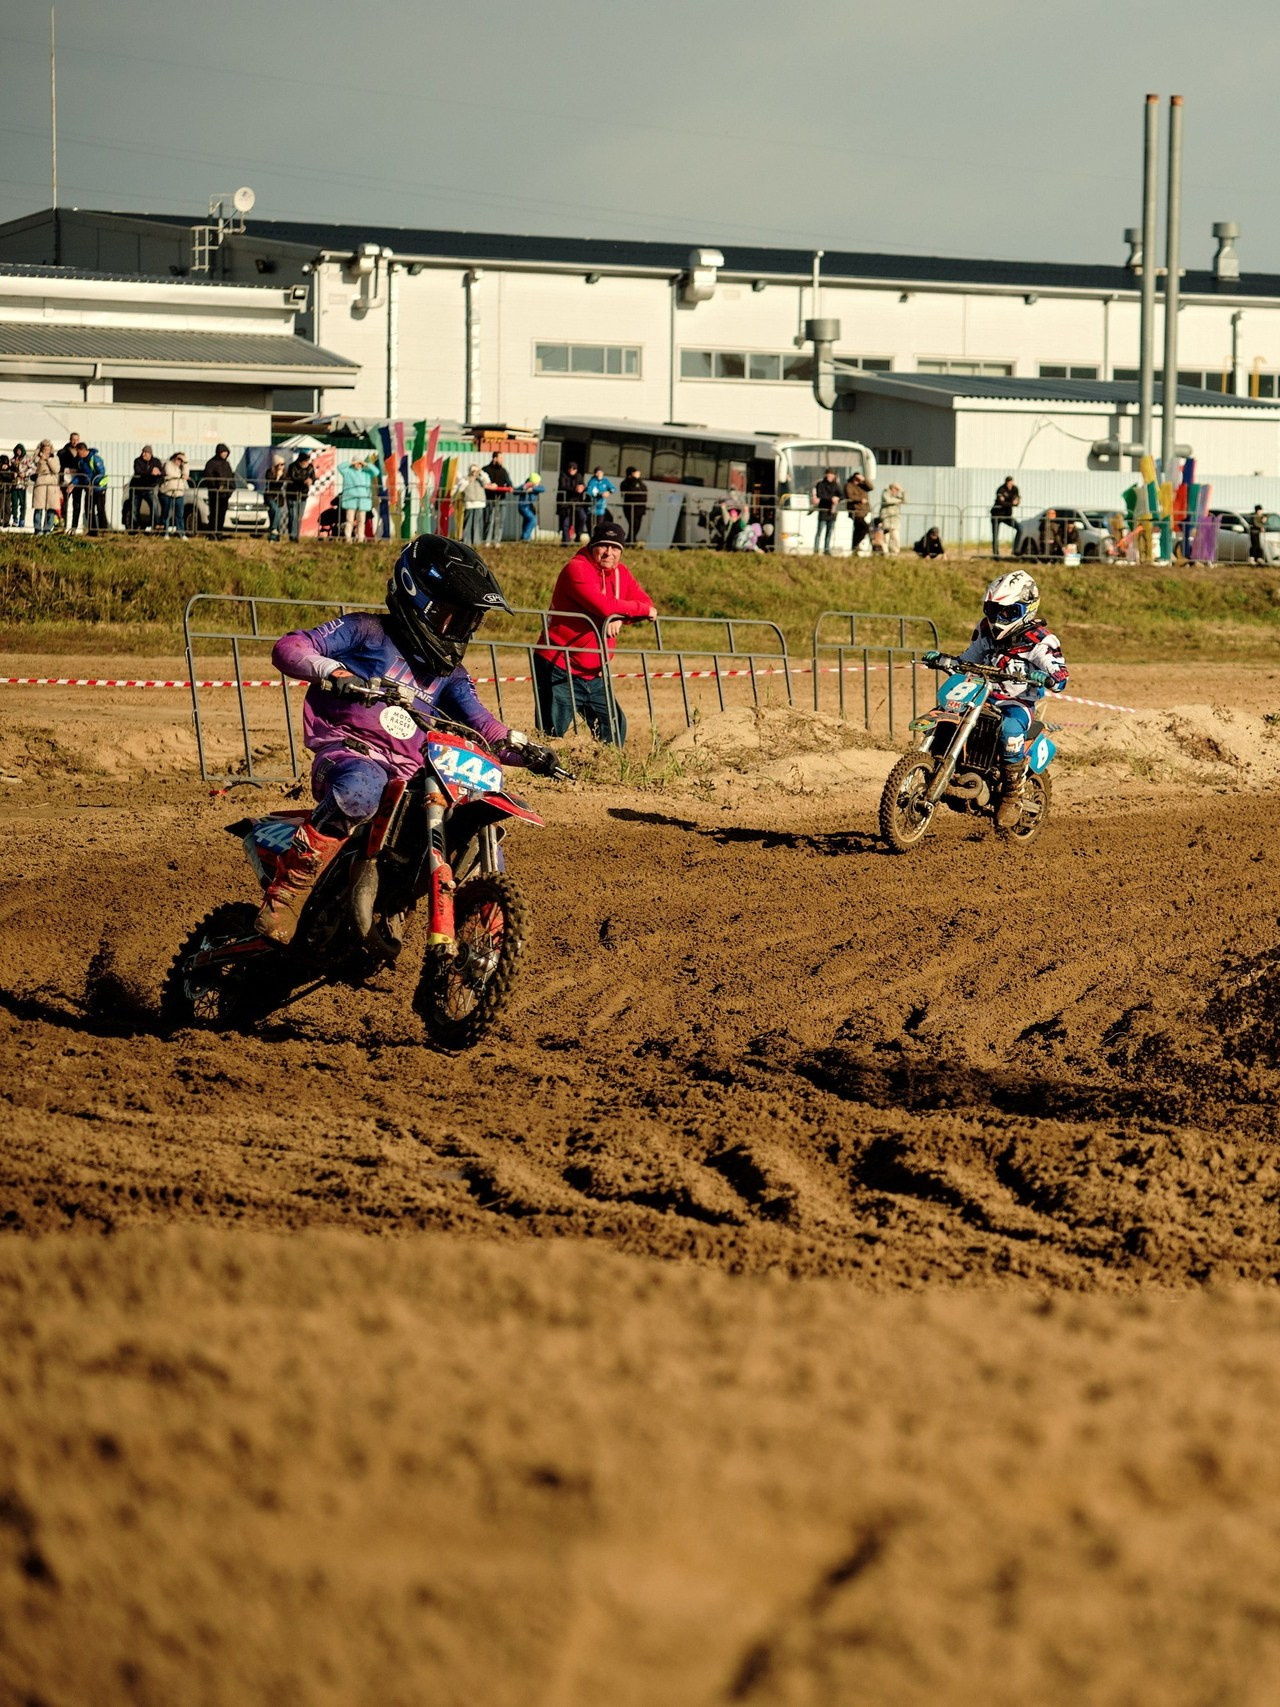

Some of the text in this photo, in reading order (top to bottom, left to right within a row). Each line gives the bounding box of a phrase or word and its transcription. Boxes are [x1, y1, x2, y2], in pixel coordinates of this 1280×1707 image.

[945, 682, 977, 701] 8
[393, 712, 412, 724] MOTO
[433, 749, 502, 794] 444
